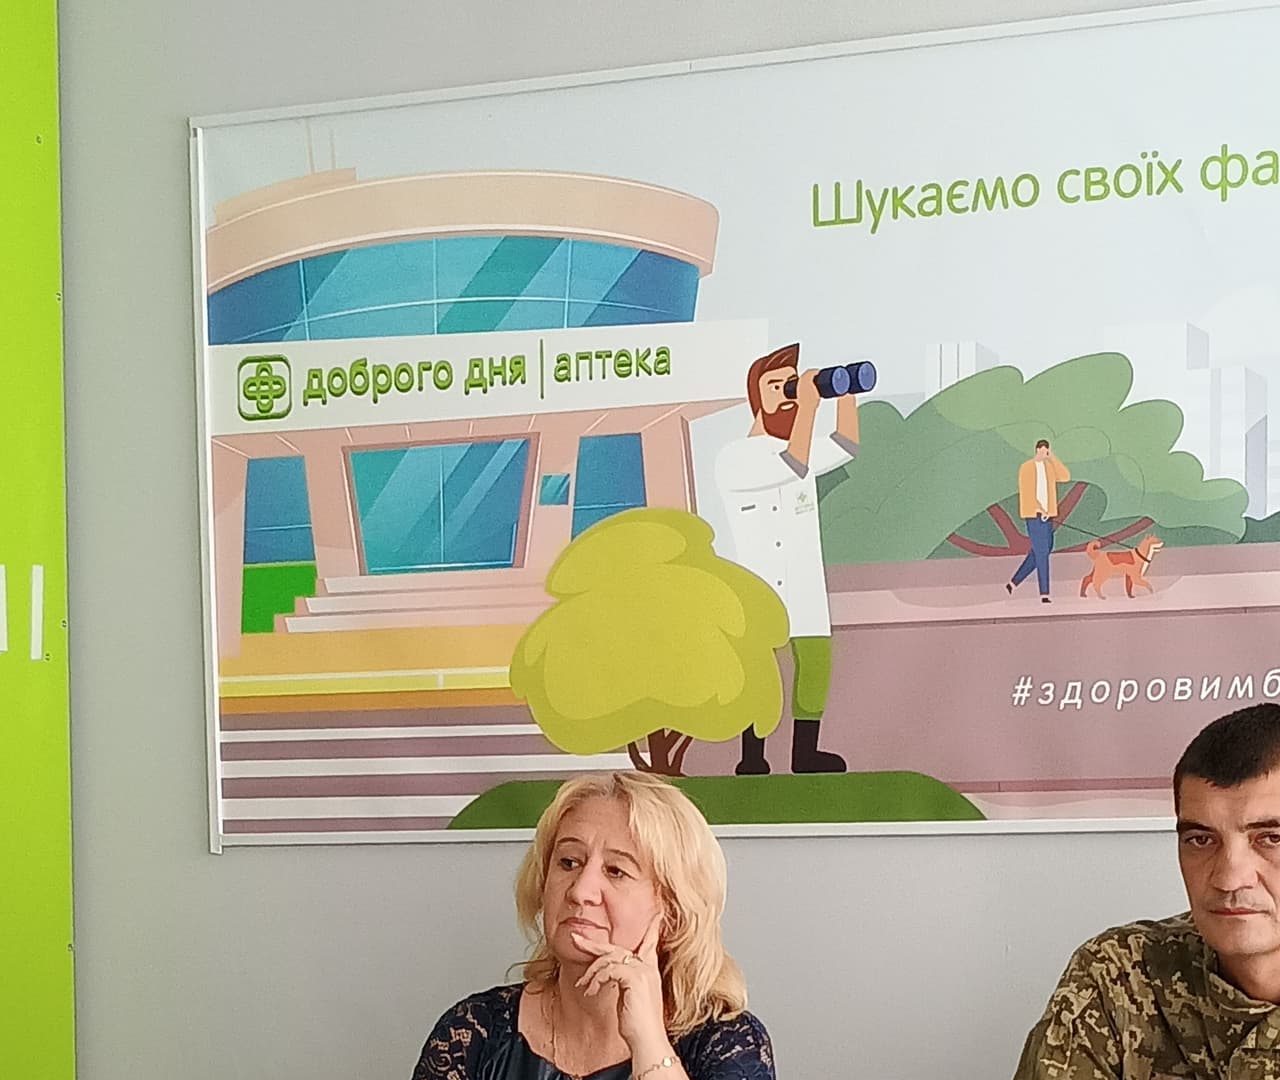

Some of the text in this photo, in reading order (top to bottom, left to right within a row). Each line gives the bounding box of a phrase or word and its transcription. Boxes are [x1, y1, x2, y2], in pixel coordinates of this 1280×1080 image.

[812, 173, 1040, 234] Шукаємо
[1057, 151, 1184, 203] своїх
[302, 346, 671, 406] доброго дня аптека
